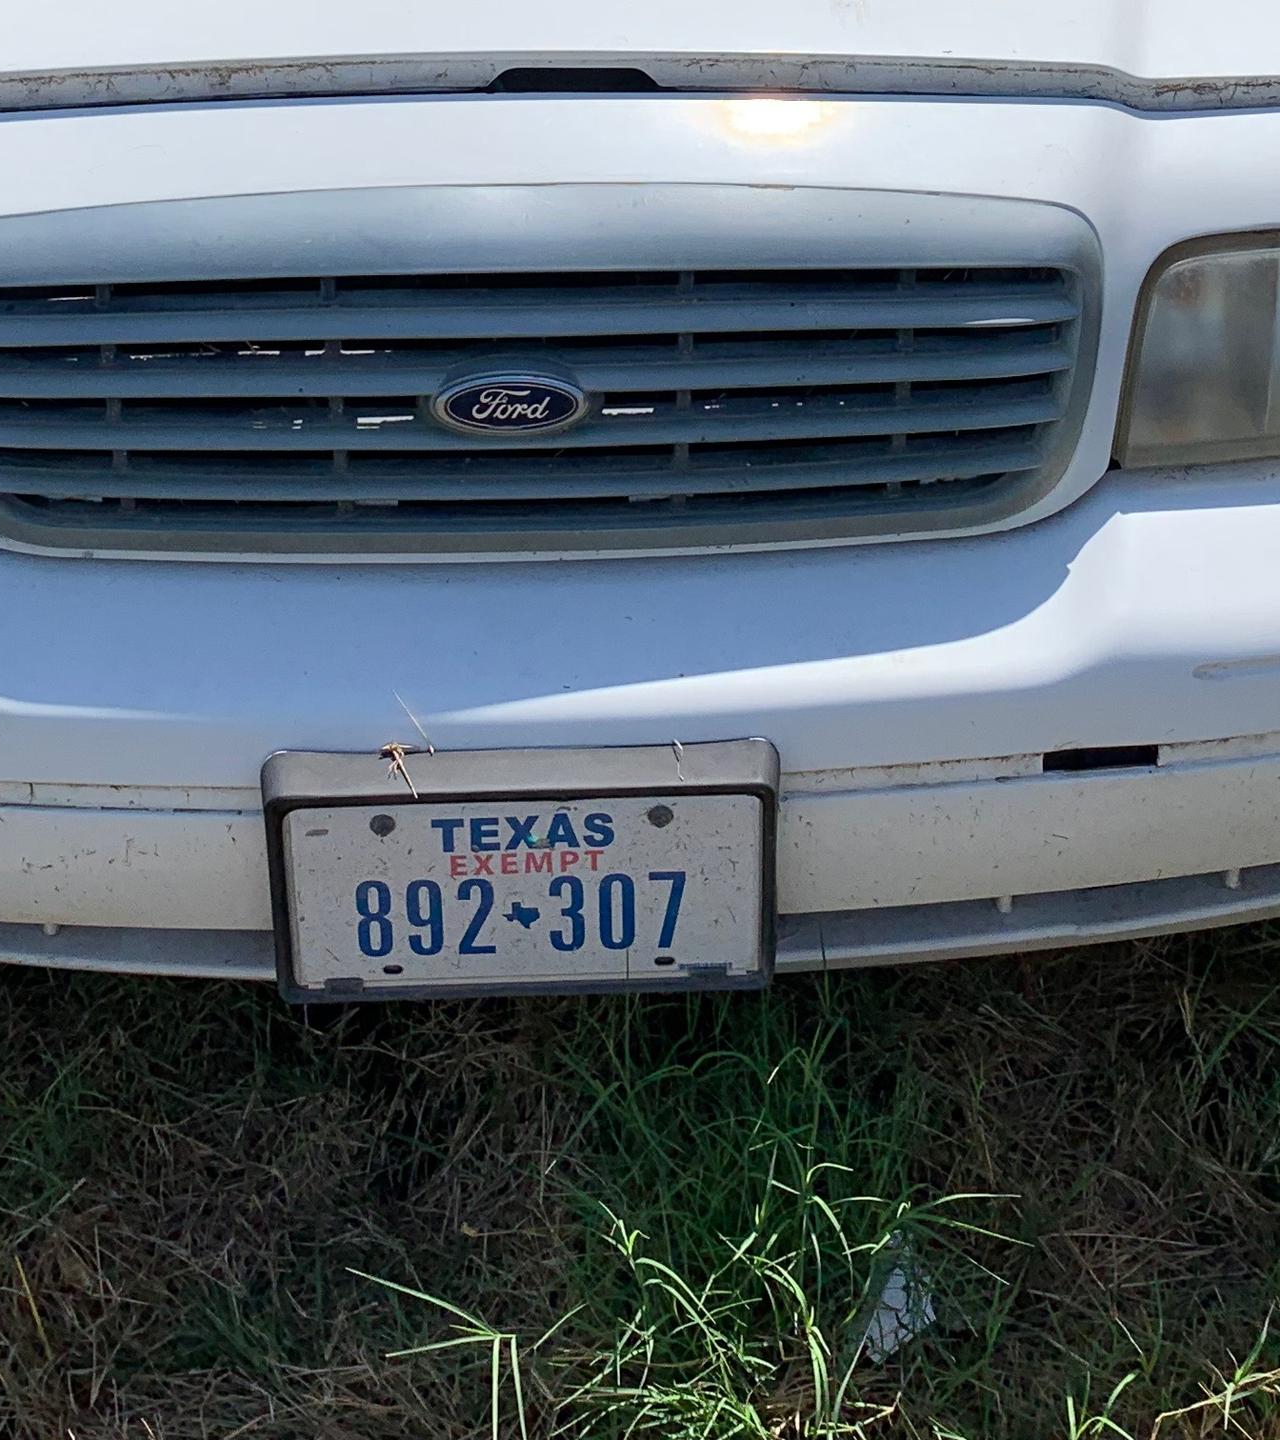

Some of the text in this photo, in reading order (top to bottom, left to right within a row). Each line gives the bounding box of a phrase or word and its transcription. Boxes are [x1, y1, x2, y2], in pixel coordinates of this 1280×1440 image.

[471, 389, 552, 420] Ford
[431, 812, 615, 853] TEXAS
[450, 850, 605, 877] EXEMPT
[355, 871, 687, 957] 892 307
